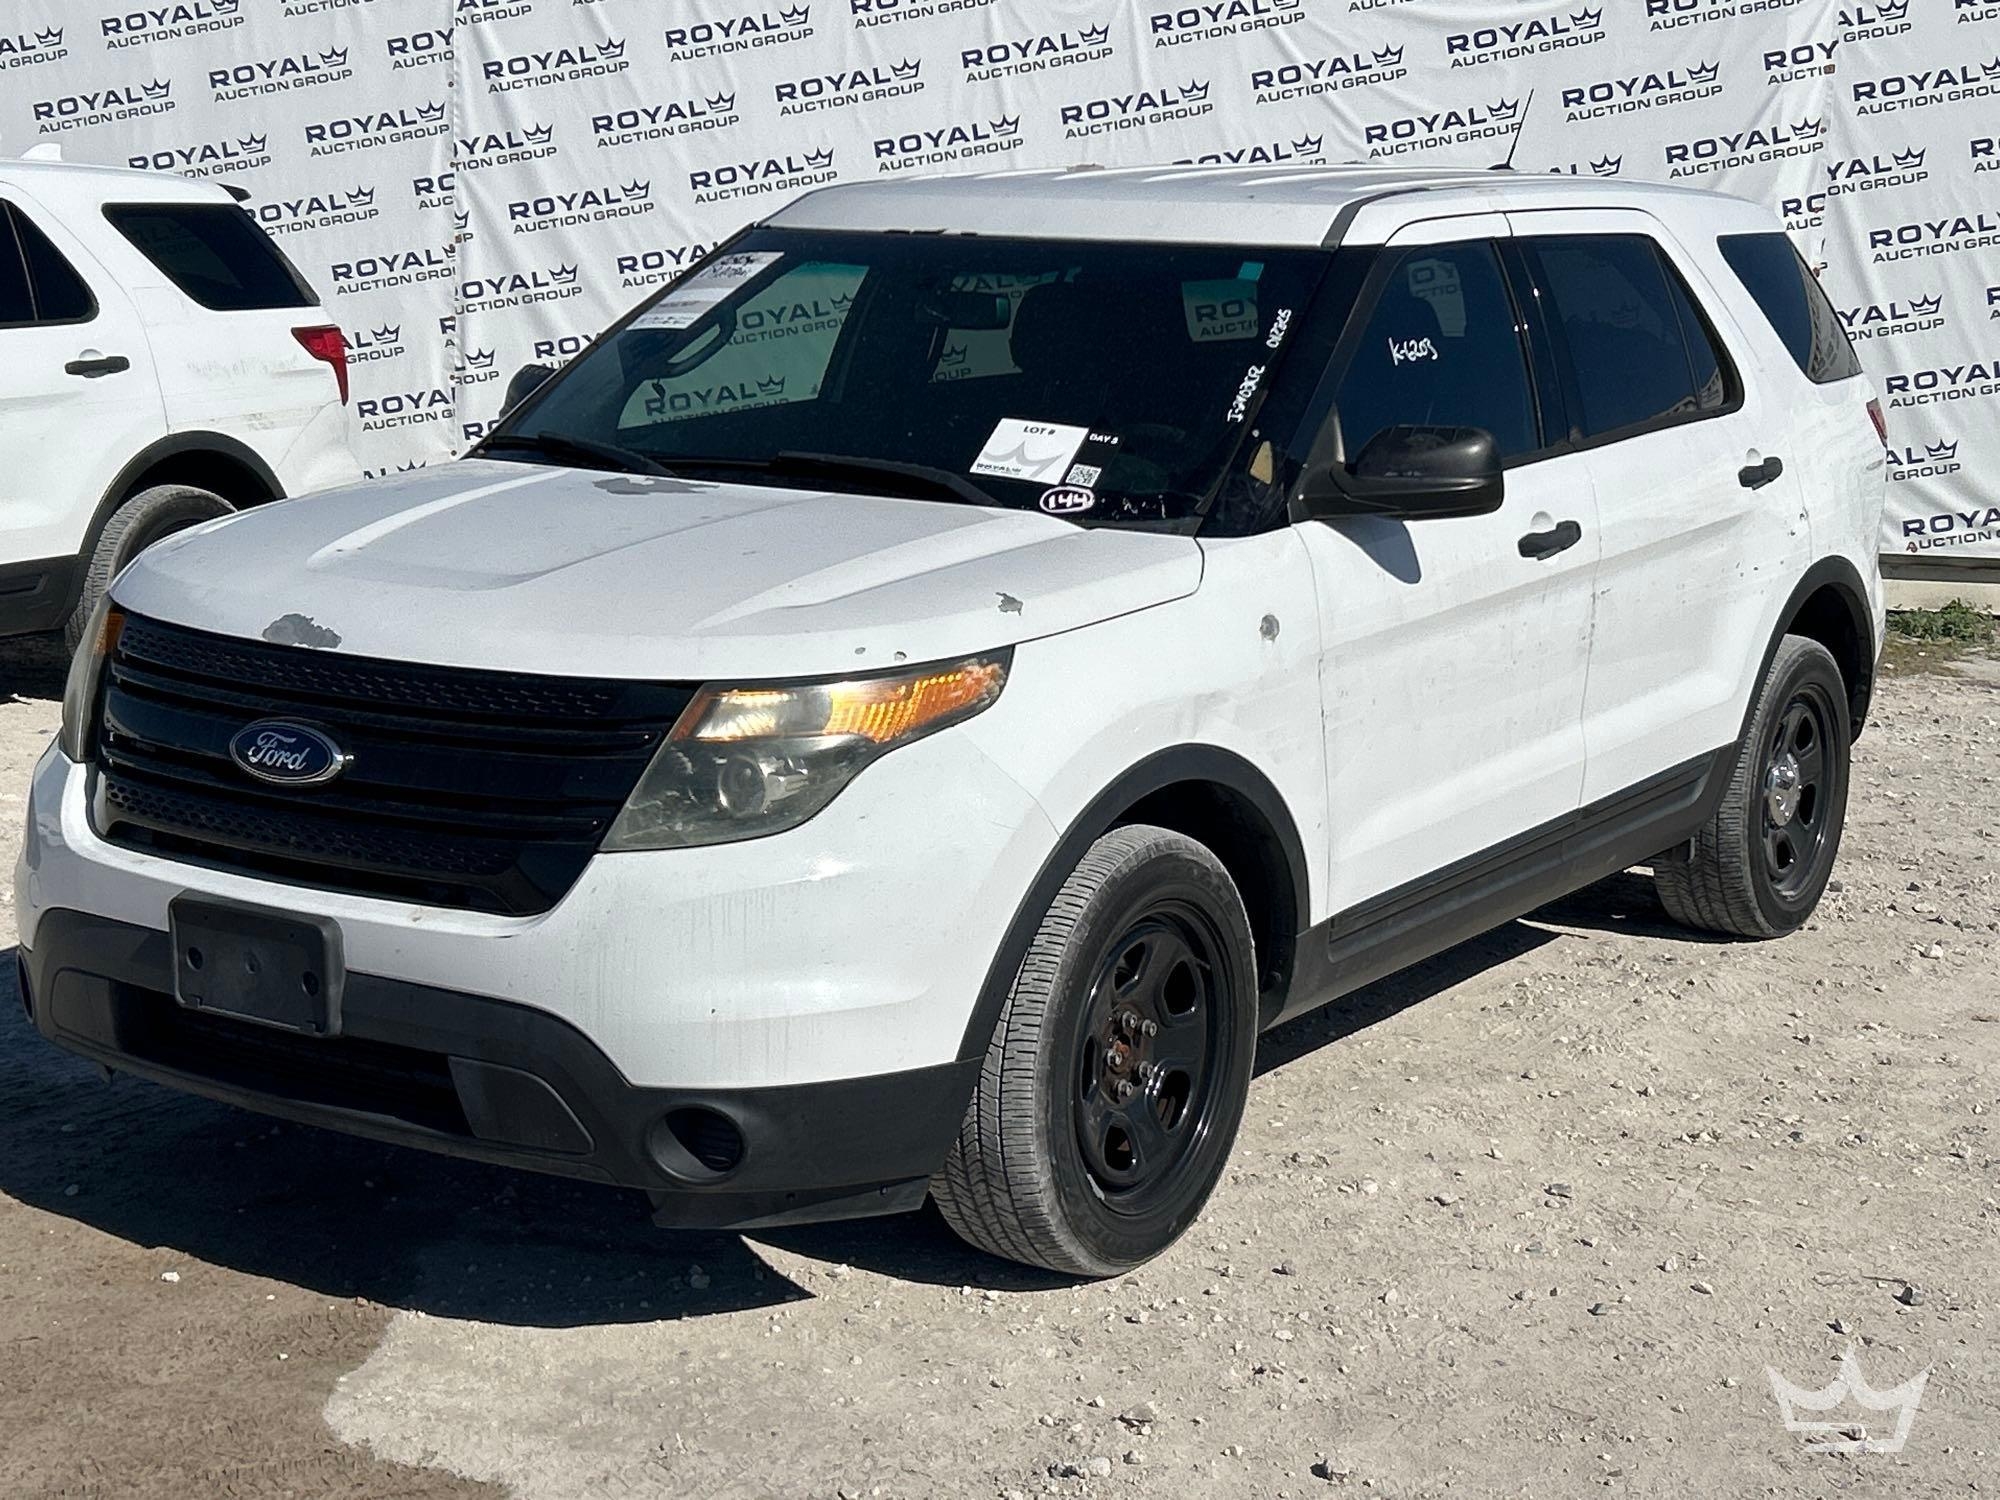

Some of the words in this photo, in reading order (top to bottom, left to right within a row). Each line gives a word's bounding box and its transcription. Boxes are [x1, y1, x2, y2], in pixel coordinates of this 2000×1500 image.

[101, 3, 212, 36] ROYAL
[471, 5, 531, 23] GROUP
[856, 6, 933, 28] AUCTION
[938, 0, 996, 14] GROU
[1151, 0, 1270, 33] ROYAL
[1156, 25, 1236, 48] AUCTION
[1241, 12, 1305, 31] GROUP
[1651, 7, 1735, 31] AUCTION
[107, 28, 181, 49] AUCTION
[185, 17, 244, 35] GROUP
[387, 28, 454, 56] ROY
[665, 14, 780, 48] ROYAL
[671, 40, 748, 62] AUCTION
[752, 28, 813, 47] GROUP
[1447, 17, 1570, 54] ROYAL
[1844, 23, 1911, 42] GROUP
[10, 49, 67, 67] GROUP
[393, 50, 454, 70] AUCTIO
[483, 47, 596, 79] ROYAL
[962, 33, 1079, 68] ROYAL
[967, 60, 1045, 83] AUCTION
[1050, 48, 1112, 67] GROUP
[1451, 45, 1534, 68] AUCTION
[1539, 32, 1605, 52] GROUP
[1764, 40, 1838, 70] ROY
[209, 55, 320, 88] ROYAL
[215, 81, 289, 102] AUCTION
[293, 69, 352, 87] GROUP
[489, 73, 565, 93] AUCTION
[569, 62, 629, 79] GROUP
[775, 68, 891, 102] ROYAL
[1252, 54, 1372, 90] ROYAL
[1257, 81, 1337, 104] AUCTION
[1342, 69, 1407, 88] GROUP
[1768, 64, 1828, 85] AUCTI
[1853, 66, 1980, 101] ROYAL
[33, 88, 142, 120] ROYAL
[781, 94, 858, 116] AUCTION
[863, 83, 924, 101] GROUP
[1562, 71, 1687, 107] ROYAL
[1566, 99, 1650, 122] AUCTION
[1656, 86, 1722, 105] GROUP
[1857, 93, 1943, 116] AUCTION
[1948, 85, 2000, 101] GROU
[39, 113, 112, 134] AUCTION
[116, 102, 175, 119] GROUP
[592, 101, 706, 134] ROYAL
[1061, 89, 1179, 124] ROYAL
[1066, 116, 1145, 139] AUCTION
[1150, 104, 1212, 123] GROUP
[305, 110, 417, 143] ROYAL
[311, 136, 386, 157] AUCTION
[390, 124, 449, 142] GROUP
[598, 127, 674, 147] AUCTION
[679, 116, 739, 133] GROUP
[874, 124, 990, 158] ROYAL
[1366, 108, 1487, 144] ROYAL
[1370, 135, 1451, 159] AUCTION
[1456, 121, 1521, 143] GROUP
[454, 132, 524, 156] YAL
[456, 157, 492, 171] TION
[497, 147, 556, 164] GROUP
[880, 150, 957, 172] AUCTION
[961, 139, 1023, 157] GROUP
[1666, 127, 1790, 164] ROYAL
[1670, 154, 1754, 178] AUCTION
[1759, 142, 1823, 161] GROUP
[213, 156, 271, 174] GROUP
[690, 157, 804, 190] ROYAL
[1827, 156, 1892, 188] YAL
[1860, 172, 1928, 190] GROUP
[696, 183, 772, 203] AUCTION
[776, 171, 837, 189] GROUP
[509, 188, 621, 220] ROYAL
[514, 214, 590, 233] AUCTION
[594, 203, 654, 220] GROUP
[264, 219, 316, 236] CTION
[320, 209, 378, 226] GROUP
[1870, 214, 1996, 249] ROYAL
[617, 242, 718, 275] ROYA
[1874, 241, 1959, 263] AUCTION
[1964, 235, 2000, 249] GRO
[332, 250, 443, 281] ROYAL
[337, 275, 411, 294] AUCTION
[416, 268, 451, 281] GRO
[622, 269, 685, 288] AUCTIO
[456, 272, 549, 301] OYAL
[456, 297, 518, 315] UCTION
[522, 287, 582, 304] GROUP
[742, 303, 830, 329] OYAL
[802, 318, 844, 332] GRO
[1200, 319, 1257, 338] AUCTI
[1837, 302, 1909, 327] YAL
[1877, 319, 1944, 336] GROUP
[346, 347, 404, 363] GROUP
[456, 371, 499, 385] ROUP
[358, 387, 454, 418] ROYA
[644, 382, 757, 416] ROYAL
[1890, 388, 1975, 408] AUCTION
[363, 412, 437, 431] AUCTION
[1023, 426, 1047, 435] LOT
[1089, 433, 1111, 443] DAY
[1893, 463, 1960, 480] GROUP
[1048, 492, 1088, 510] 144
[1903, 508, 2000, 537] ROYA
[248, 731, 310, 771] Ford
